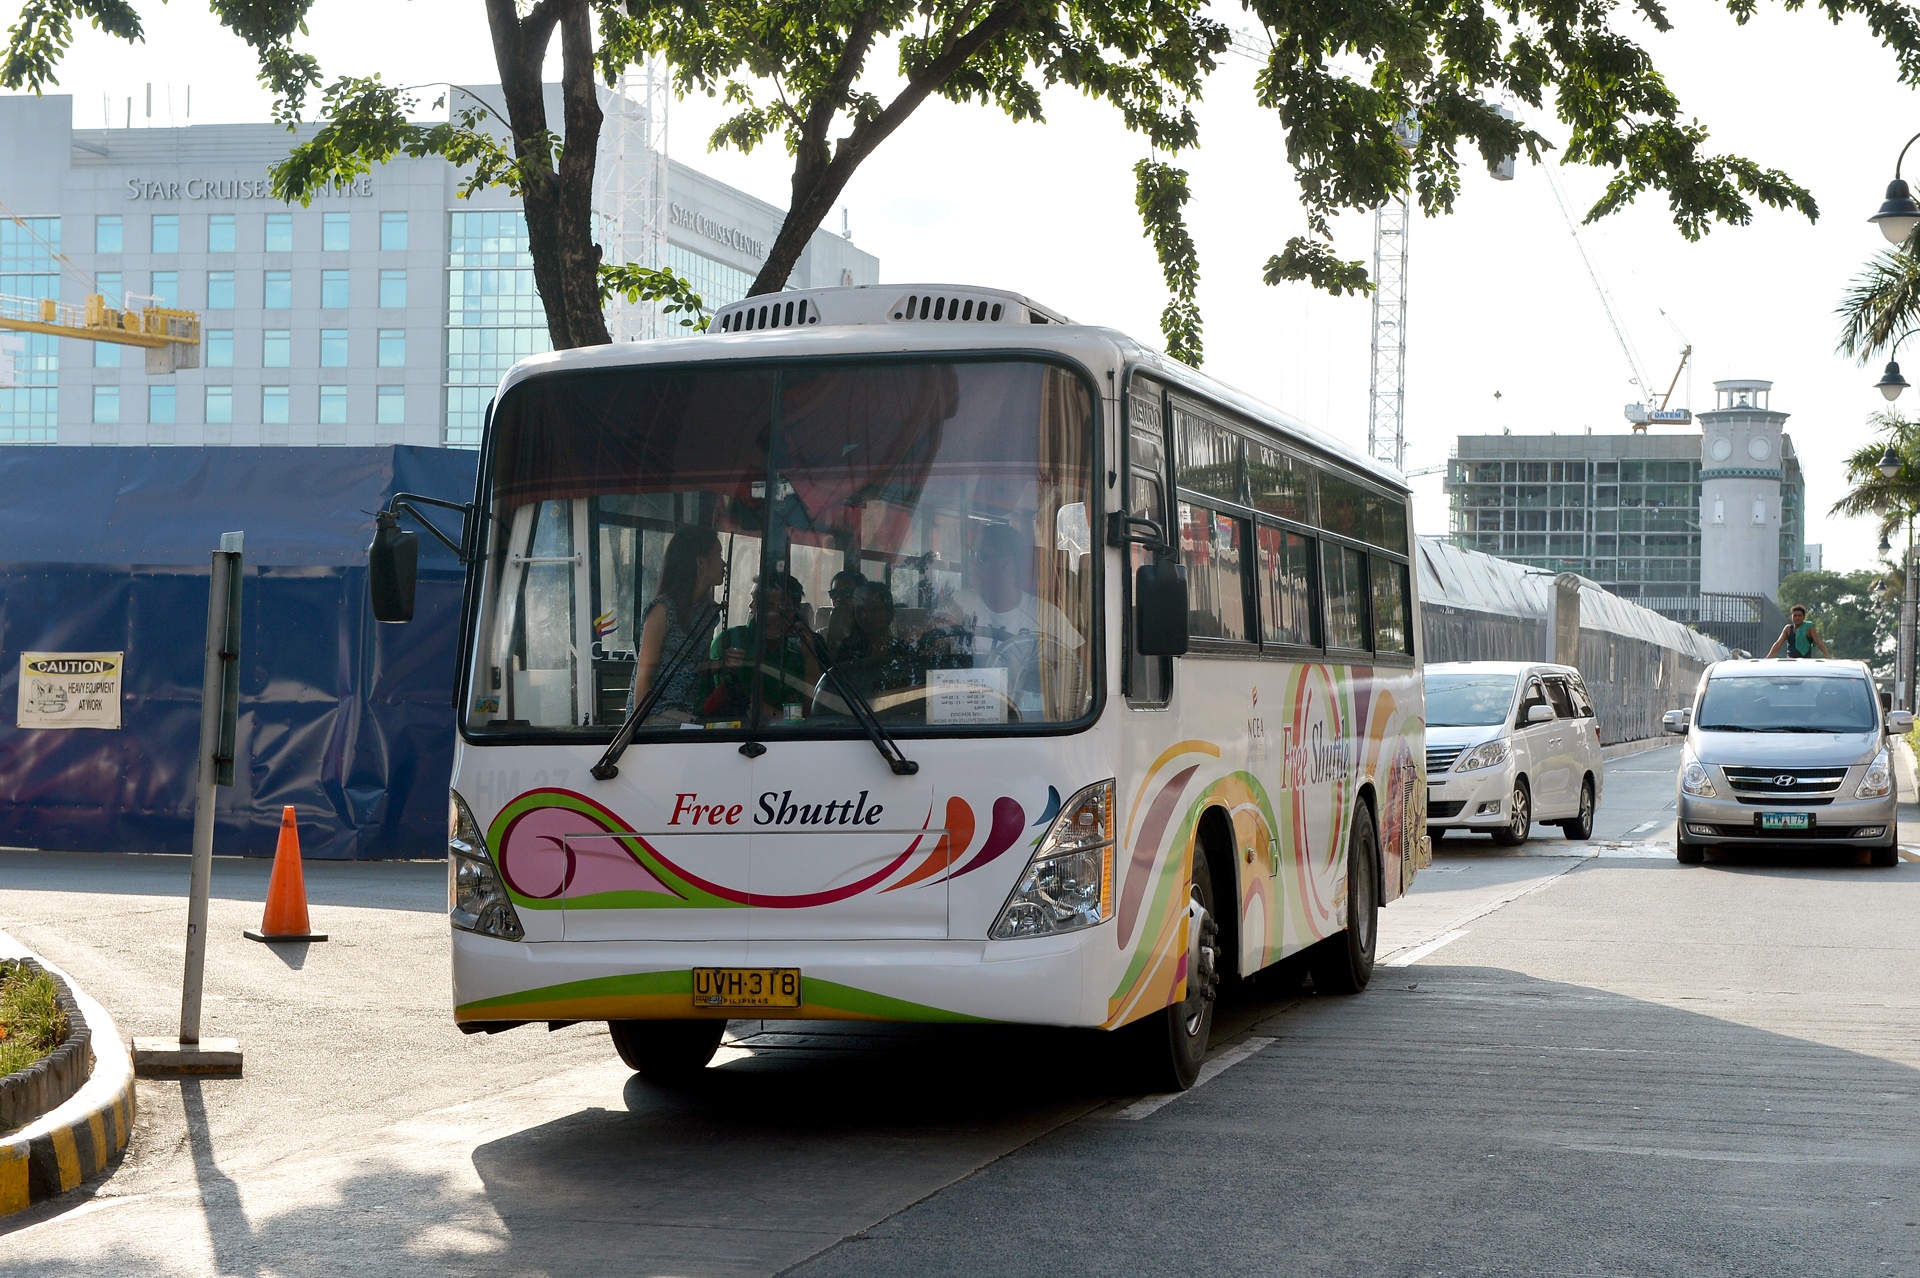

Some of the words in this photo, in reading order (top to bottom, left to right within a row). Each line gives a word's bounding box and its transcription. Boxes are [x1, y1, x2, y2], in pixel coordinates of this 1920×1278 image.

[126, 177, 182, 200] STAR
[184, 177, 275, 200] CRUISES
[671, 202, 695, 231] STAR
[696, 212, 732, 246] CRUISES
[732, 228, 764, 259] CENTRE
[37, 661, 104, 673] CAUTION
[68, 682, 85, 694] HEAVY
[85, 682, 115, 694] EQUIPMENT
[78, 700, 85, 711] AT
[85, 700, 103, 711] WORK
[1247, 717, 1264, 738] NCEA
[1281, 726, 1308, 789] Free
[1310, 715, 1350, 785] Shuttle
[667, 792, 743, 826] Free
[753, 790, 883, 826] Shuttle
